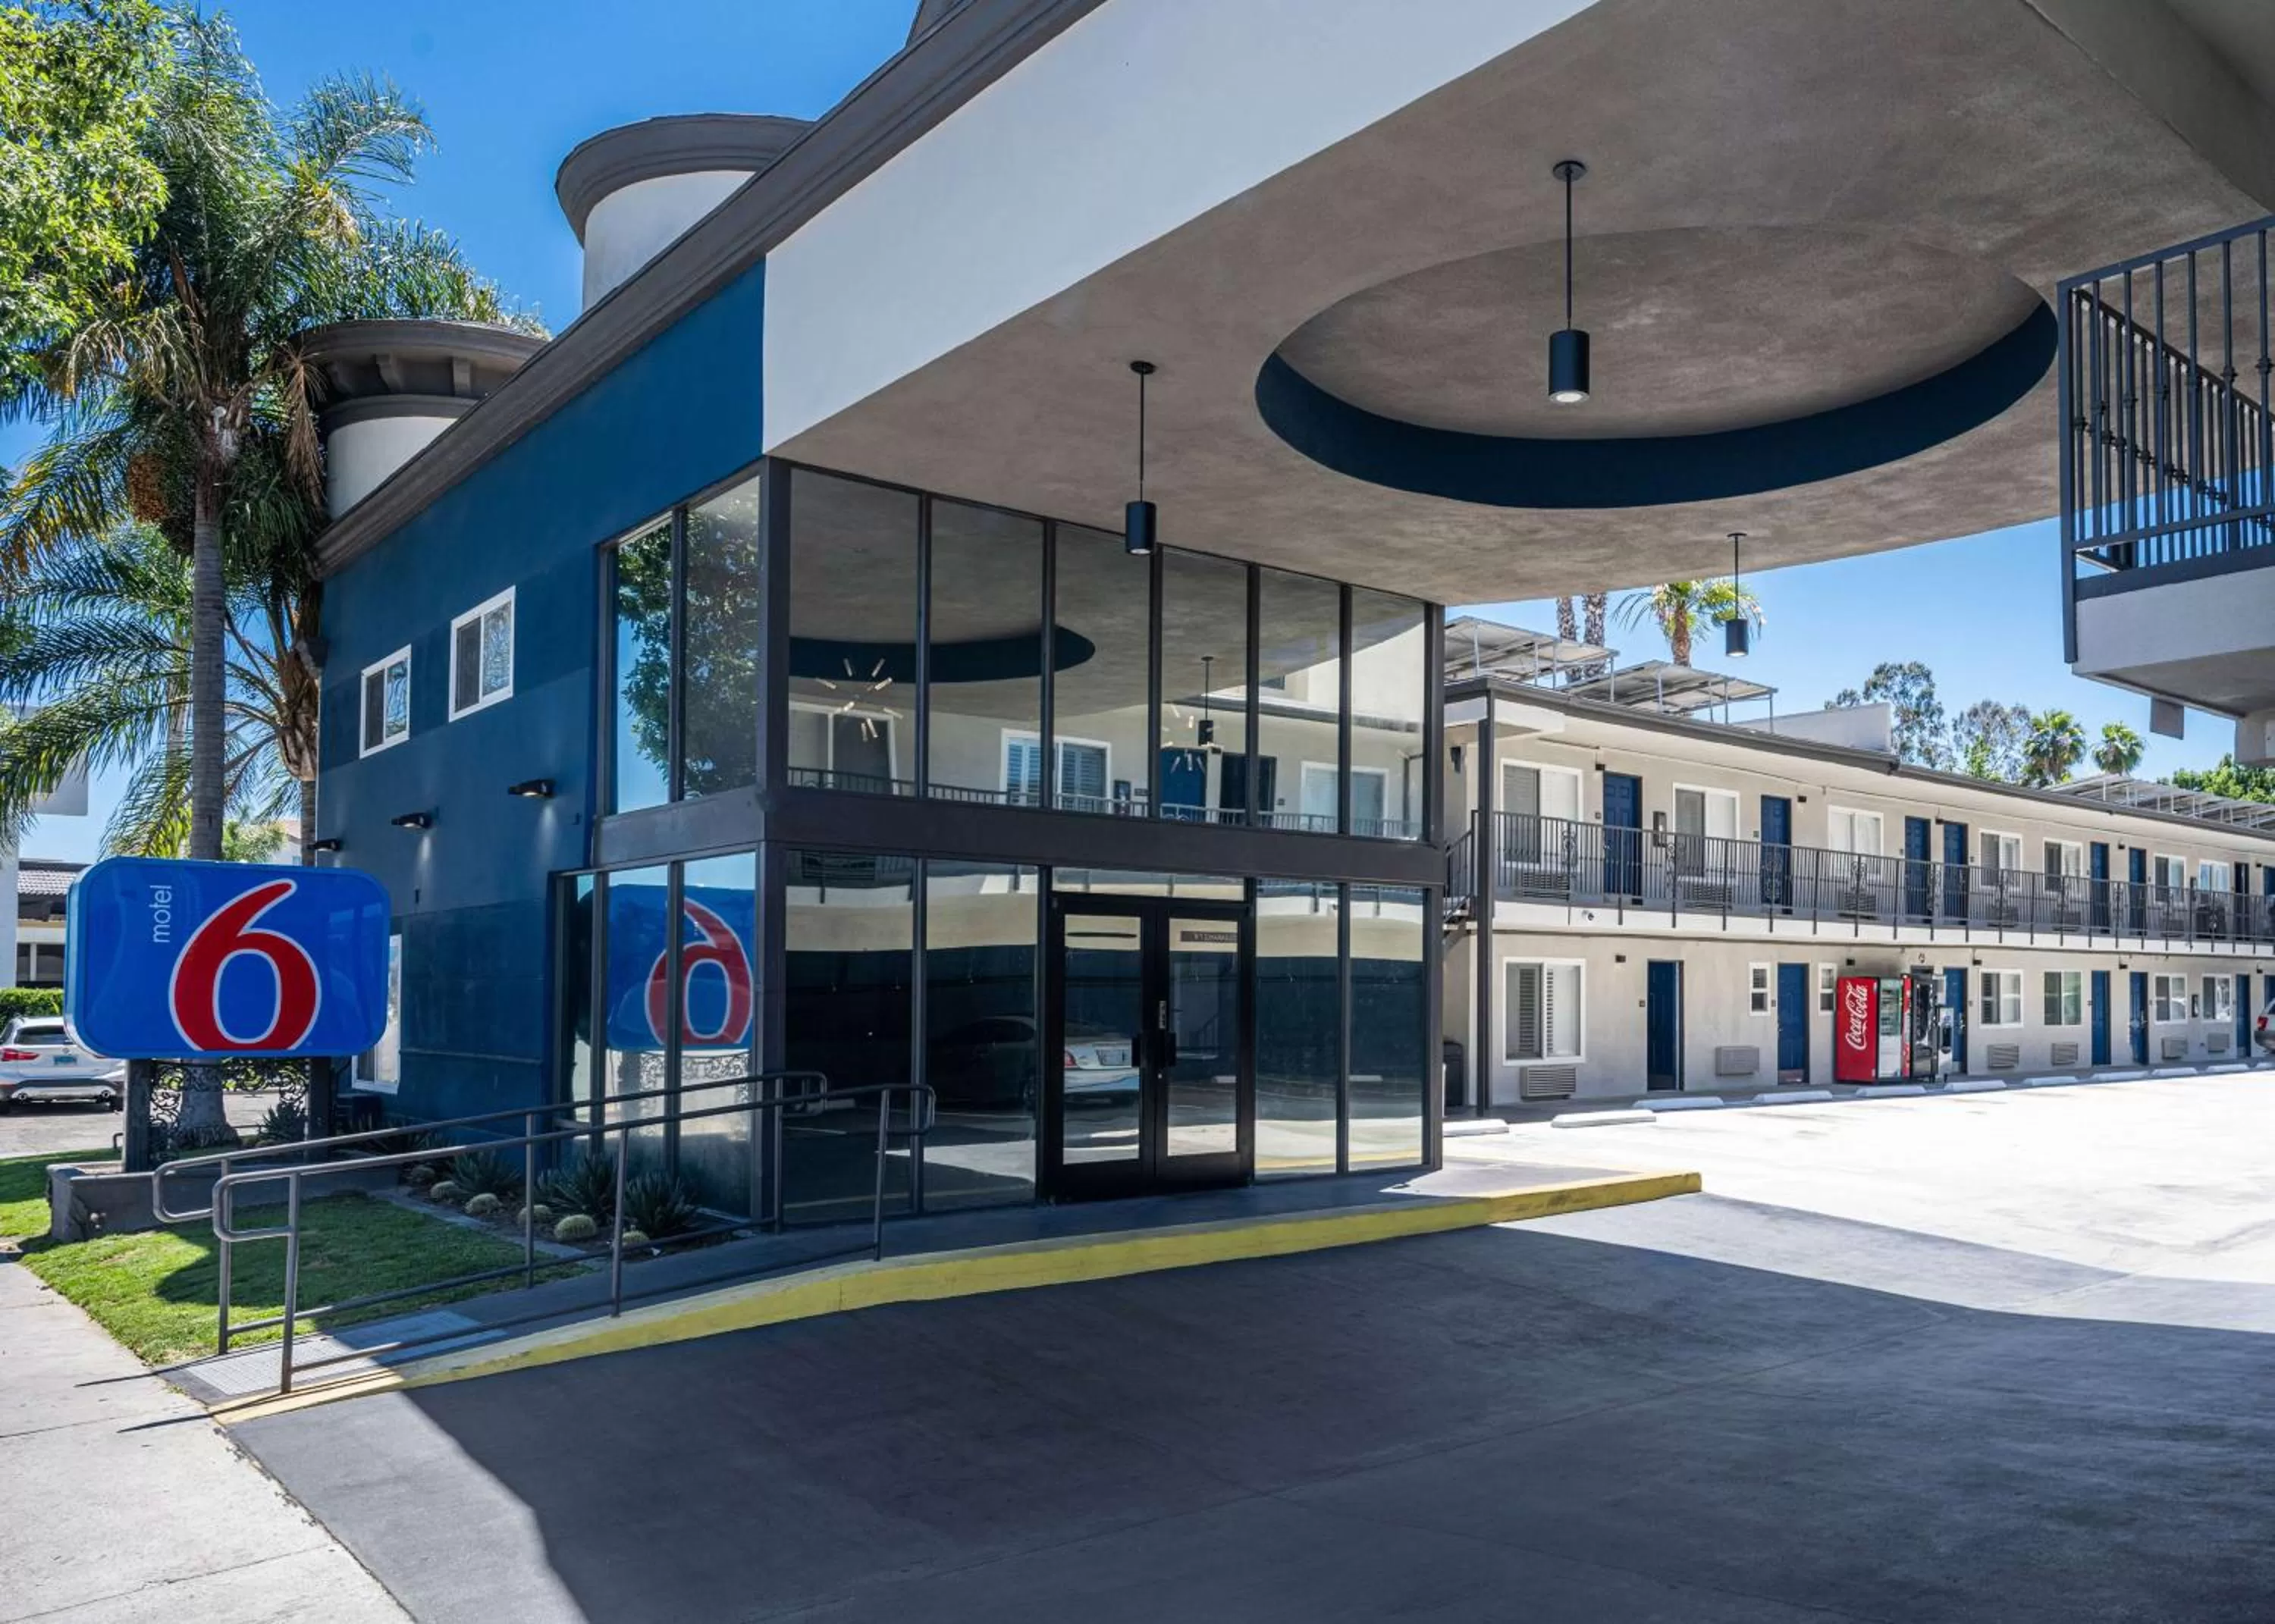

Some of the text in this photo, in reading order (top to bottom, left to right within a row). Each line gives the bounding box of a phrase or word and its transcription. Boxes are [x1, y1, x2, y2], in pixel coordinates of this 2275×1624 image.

[149, 878, 322, 1052] motel 6
[1845, 981, 1868, 1050] Coca-Cola
